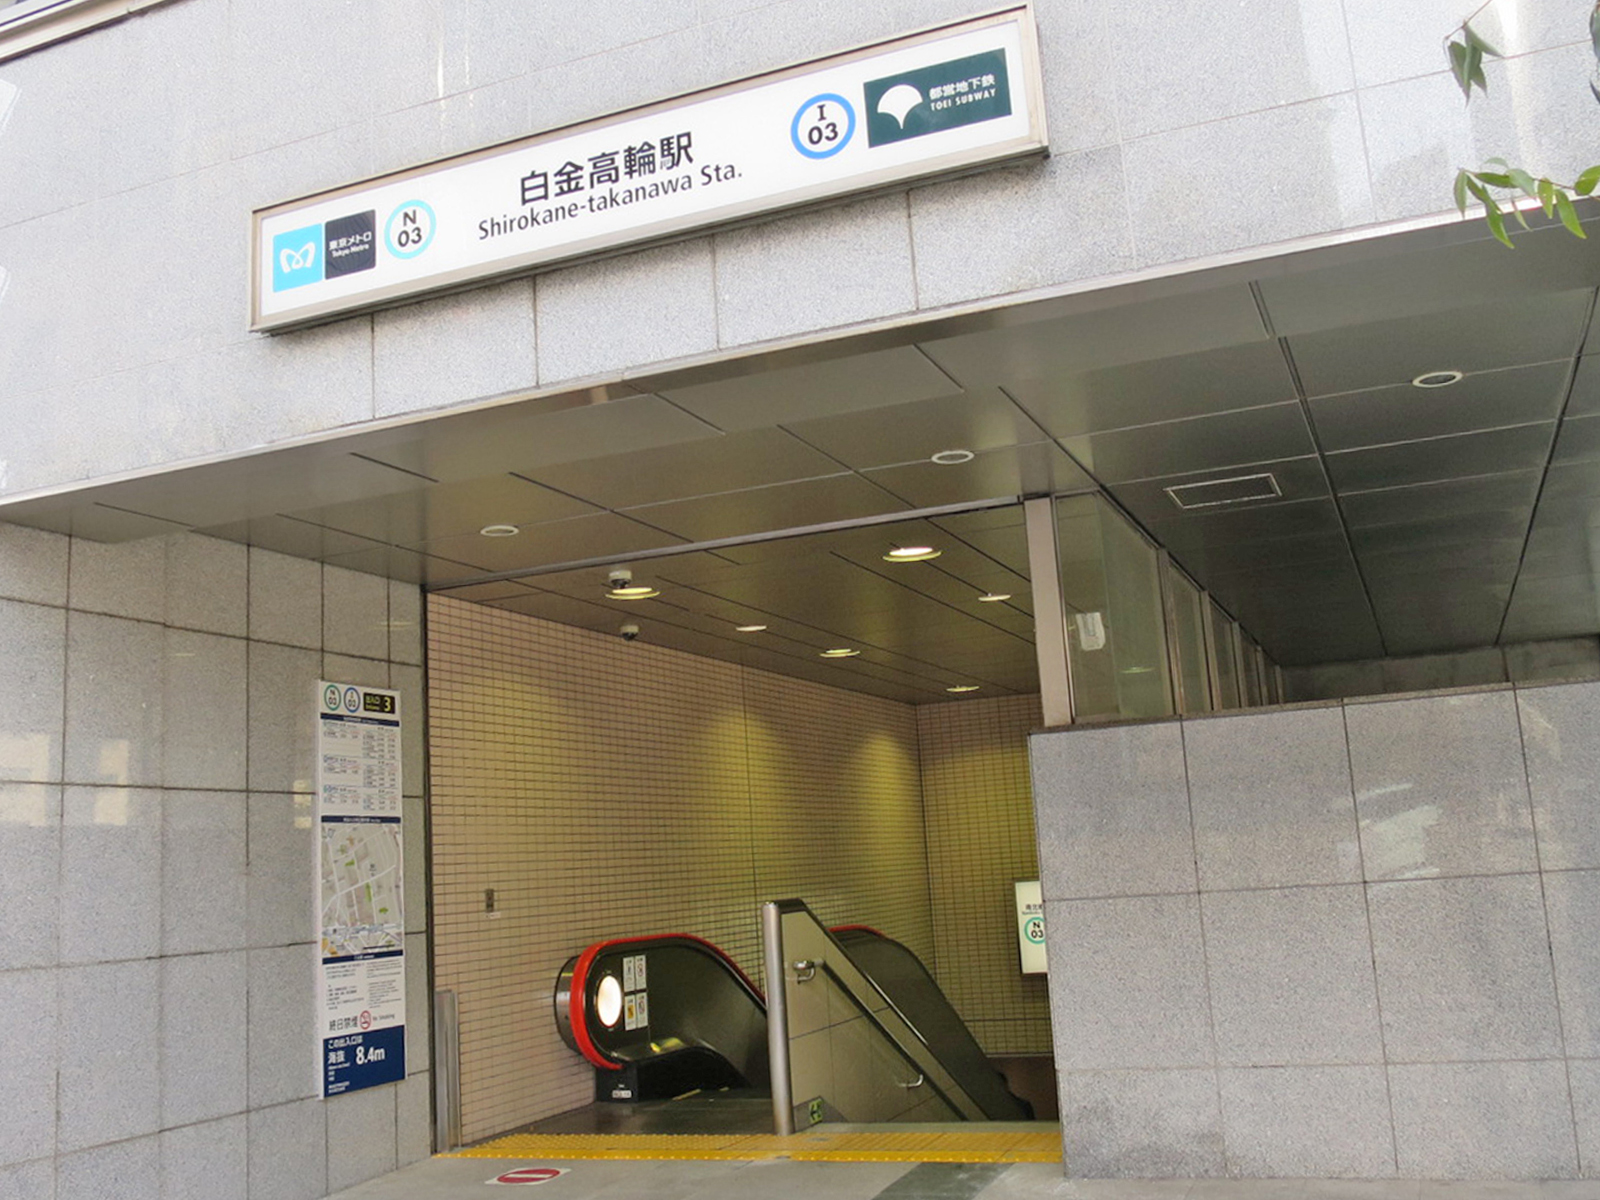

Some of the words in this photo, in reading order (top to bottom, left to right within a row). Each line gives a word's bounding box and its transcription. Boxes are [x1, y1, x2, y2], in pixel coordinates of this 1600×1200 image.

[930, 99, 952, 112] TOEI
[955, 88, 996, 106] SUBWAY
[817, 104, 827, 122] I
[808, 122, 839, 145] 03
[520, 131, 694, 206] 白金高輪駅
[478, 174, 693, 240] Shirokane-takanawa
[700, 163, 743, 187] Sta.
[403, 209, 417, 227] N
[329, 231, 372, 251] 東京メトロ
[397, 227, 422, 248] 03
[332, 248, 351, 259] Tokyo
[351, 243, 370, 254] Metro
[328, 696, 337, 706] 03
[347, 698, 357, 708] 03
[383, 696, 392, 712] 3
[1033, 921, 1041, 929] N
[1031, 930, 1044, 939] 03
[327, 1035, 363, 1049] この出入口は
[356, 1046, 386, 1065] 8.4m
